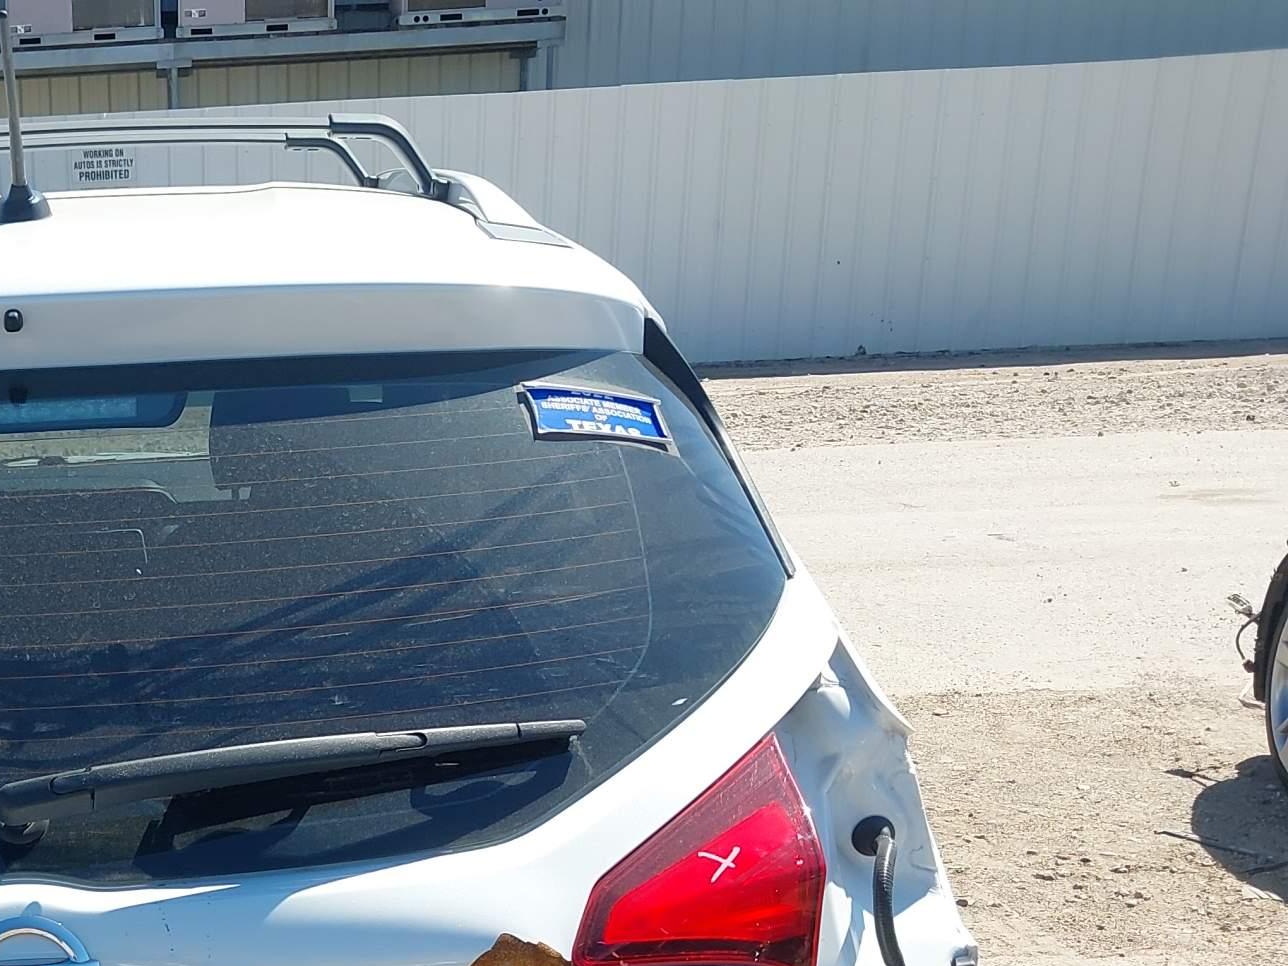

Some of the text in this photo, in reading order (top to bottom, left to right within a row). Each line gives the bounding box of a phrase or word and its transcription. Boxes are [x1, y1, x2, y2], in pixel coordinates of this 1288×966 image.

[83, 149, 124, 159] WORKING ON
[73, 158, 134, 170] AUTOS IS STRICTLY
[78, 169, 130, 182] PROHIBITED
[592, 406, 652, 424] ASSOCIATION
[594, 413, 609, 422] OF
[565, 418, 641, 435] TEXAS
